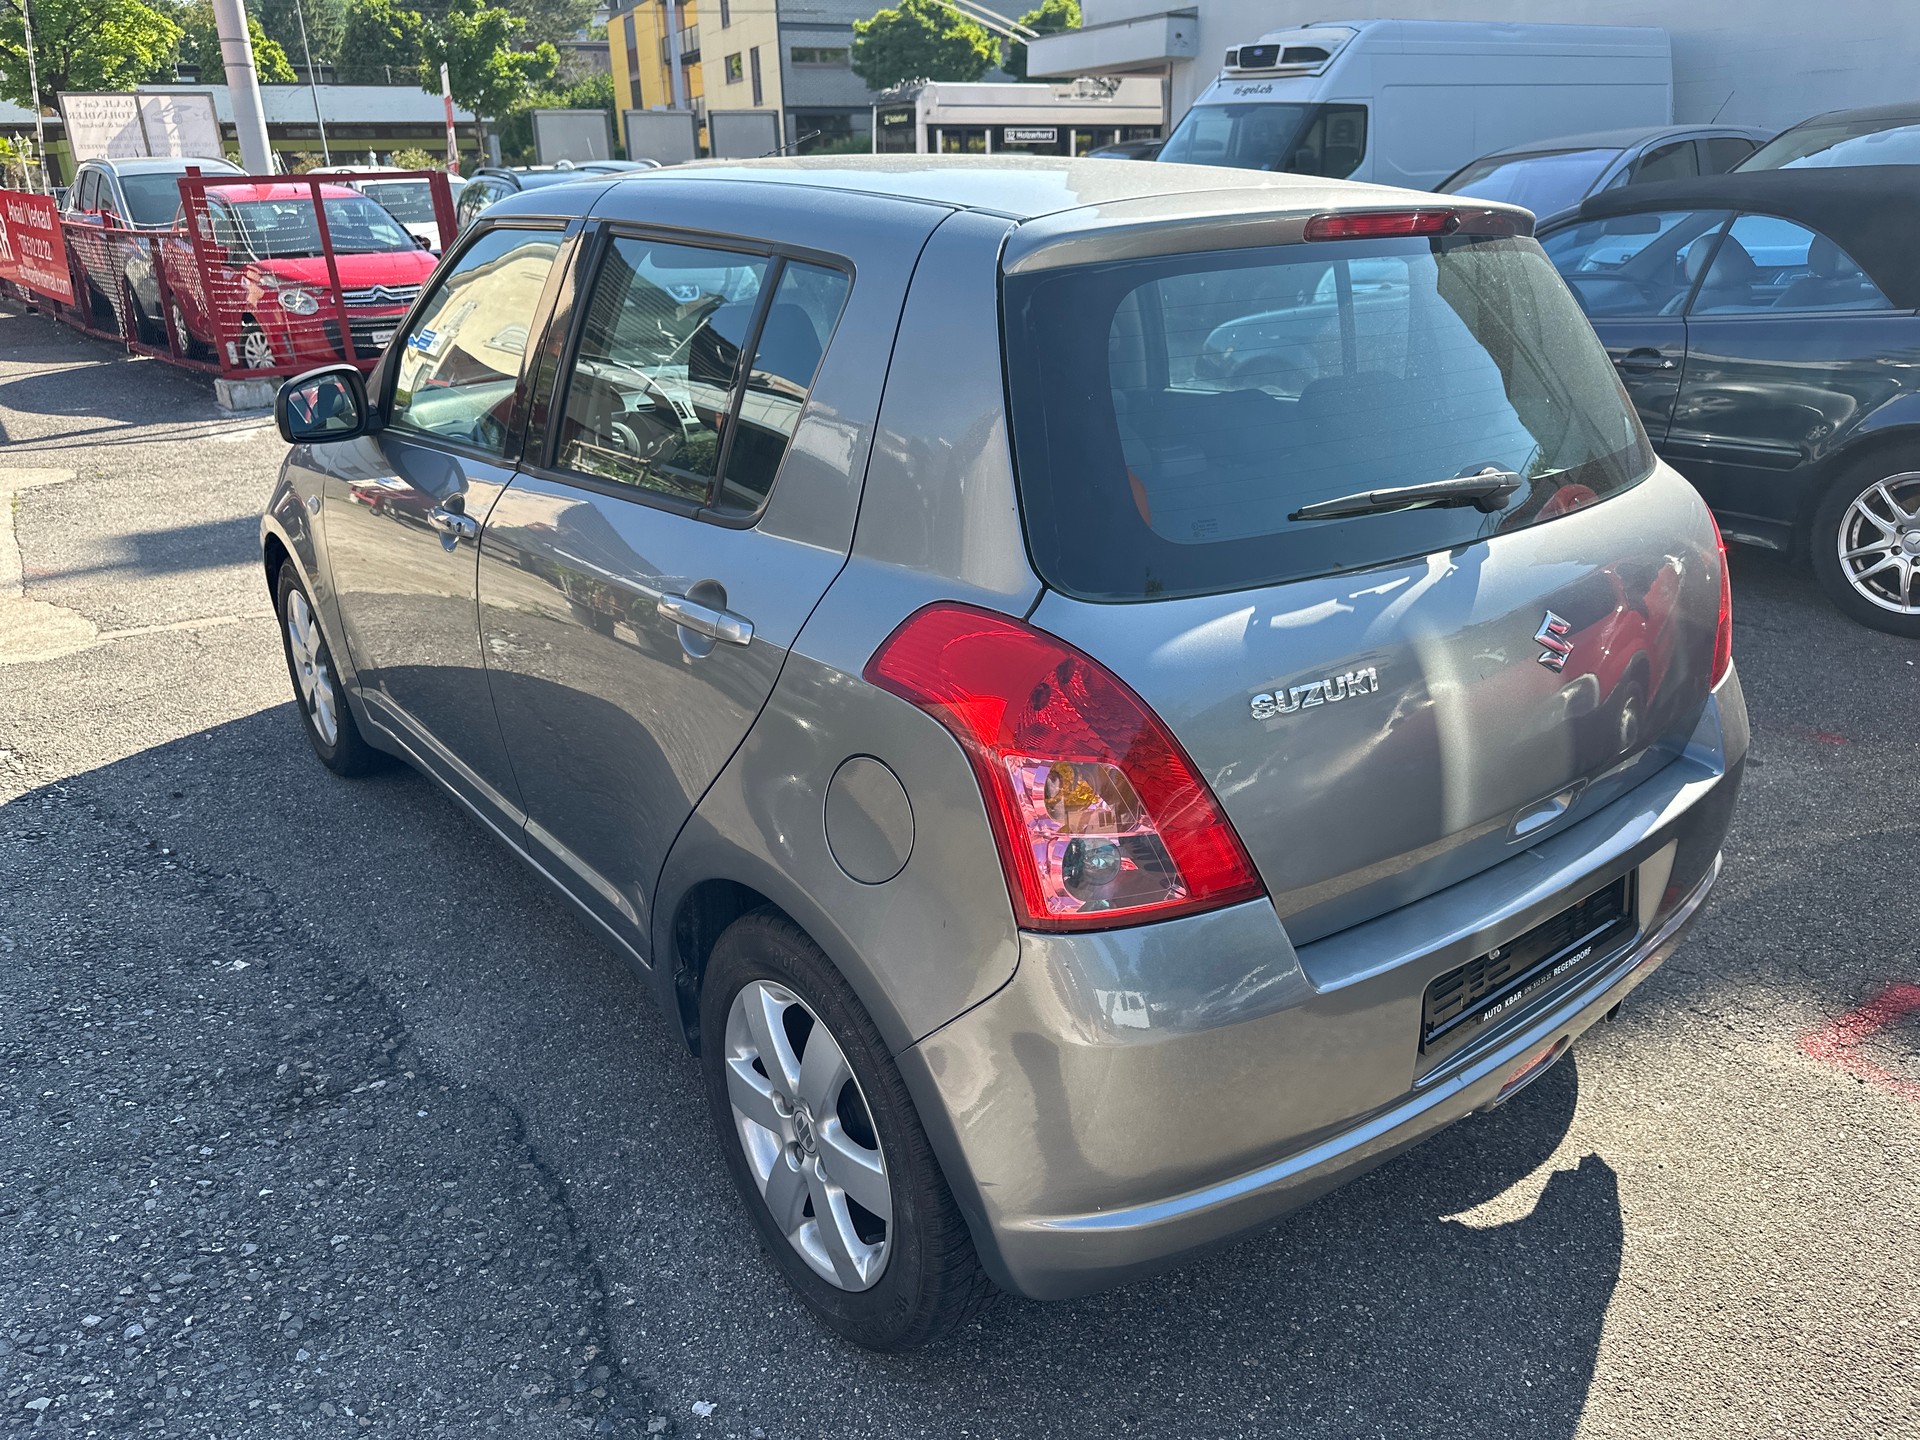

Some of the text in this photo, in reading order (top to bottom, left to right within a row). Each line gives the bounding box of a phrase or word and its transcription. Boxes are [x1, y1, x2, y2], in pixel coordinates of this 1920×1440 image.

[1250, 667, 1379, 721] SUZUKI
[1483, 1004, 1502, 1021] AUTO
[1504, 991, 1522, 1007] KBAR
[1553, 946, 1592, 977] REGENSDORF
